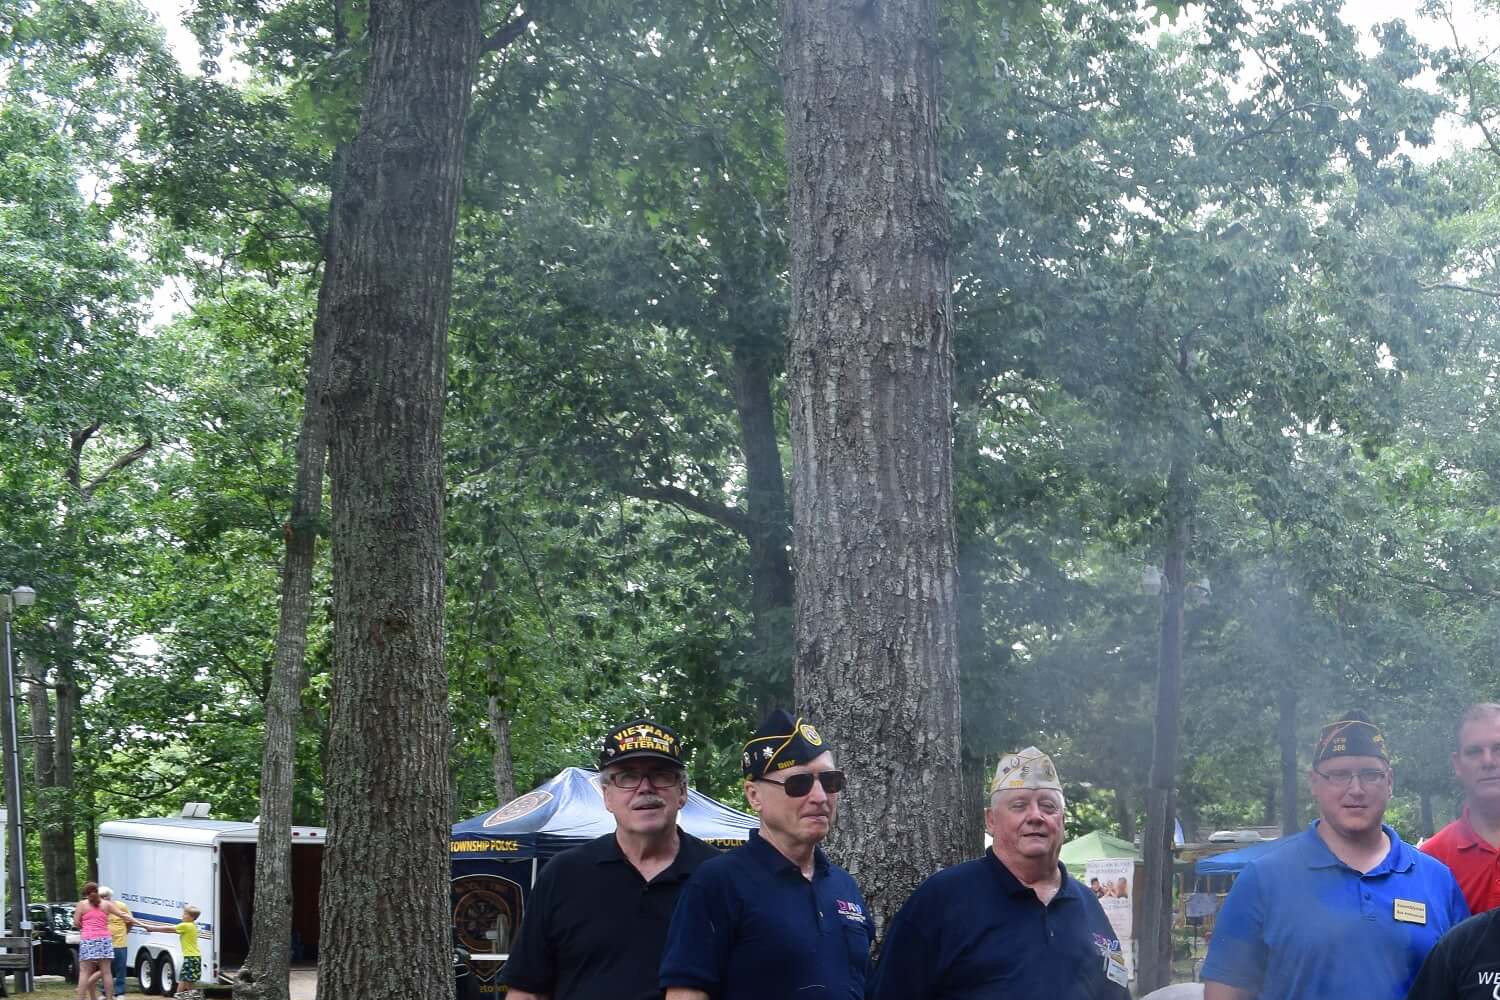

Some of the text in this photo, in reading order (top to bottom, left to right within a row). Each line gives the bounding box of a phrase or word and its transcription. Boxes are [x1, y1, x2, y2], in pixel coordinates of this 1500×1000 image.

[613, 724, 674, 744] VIETNAM
[619, 740, 669, 753] VETERAN
[450, 839, 518, 852] TOWNSHIP POLICE
